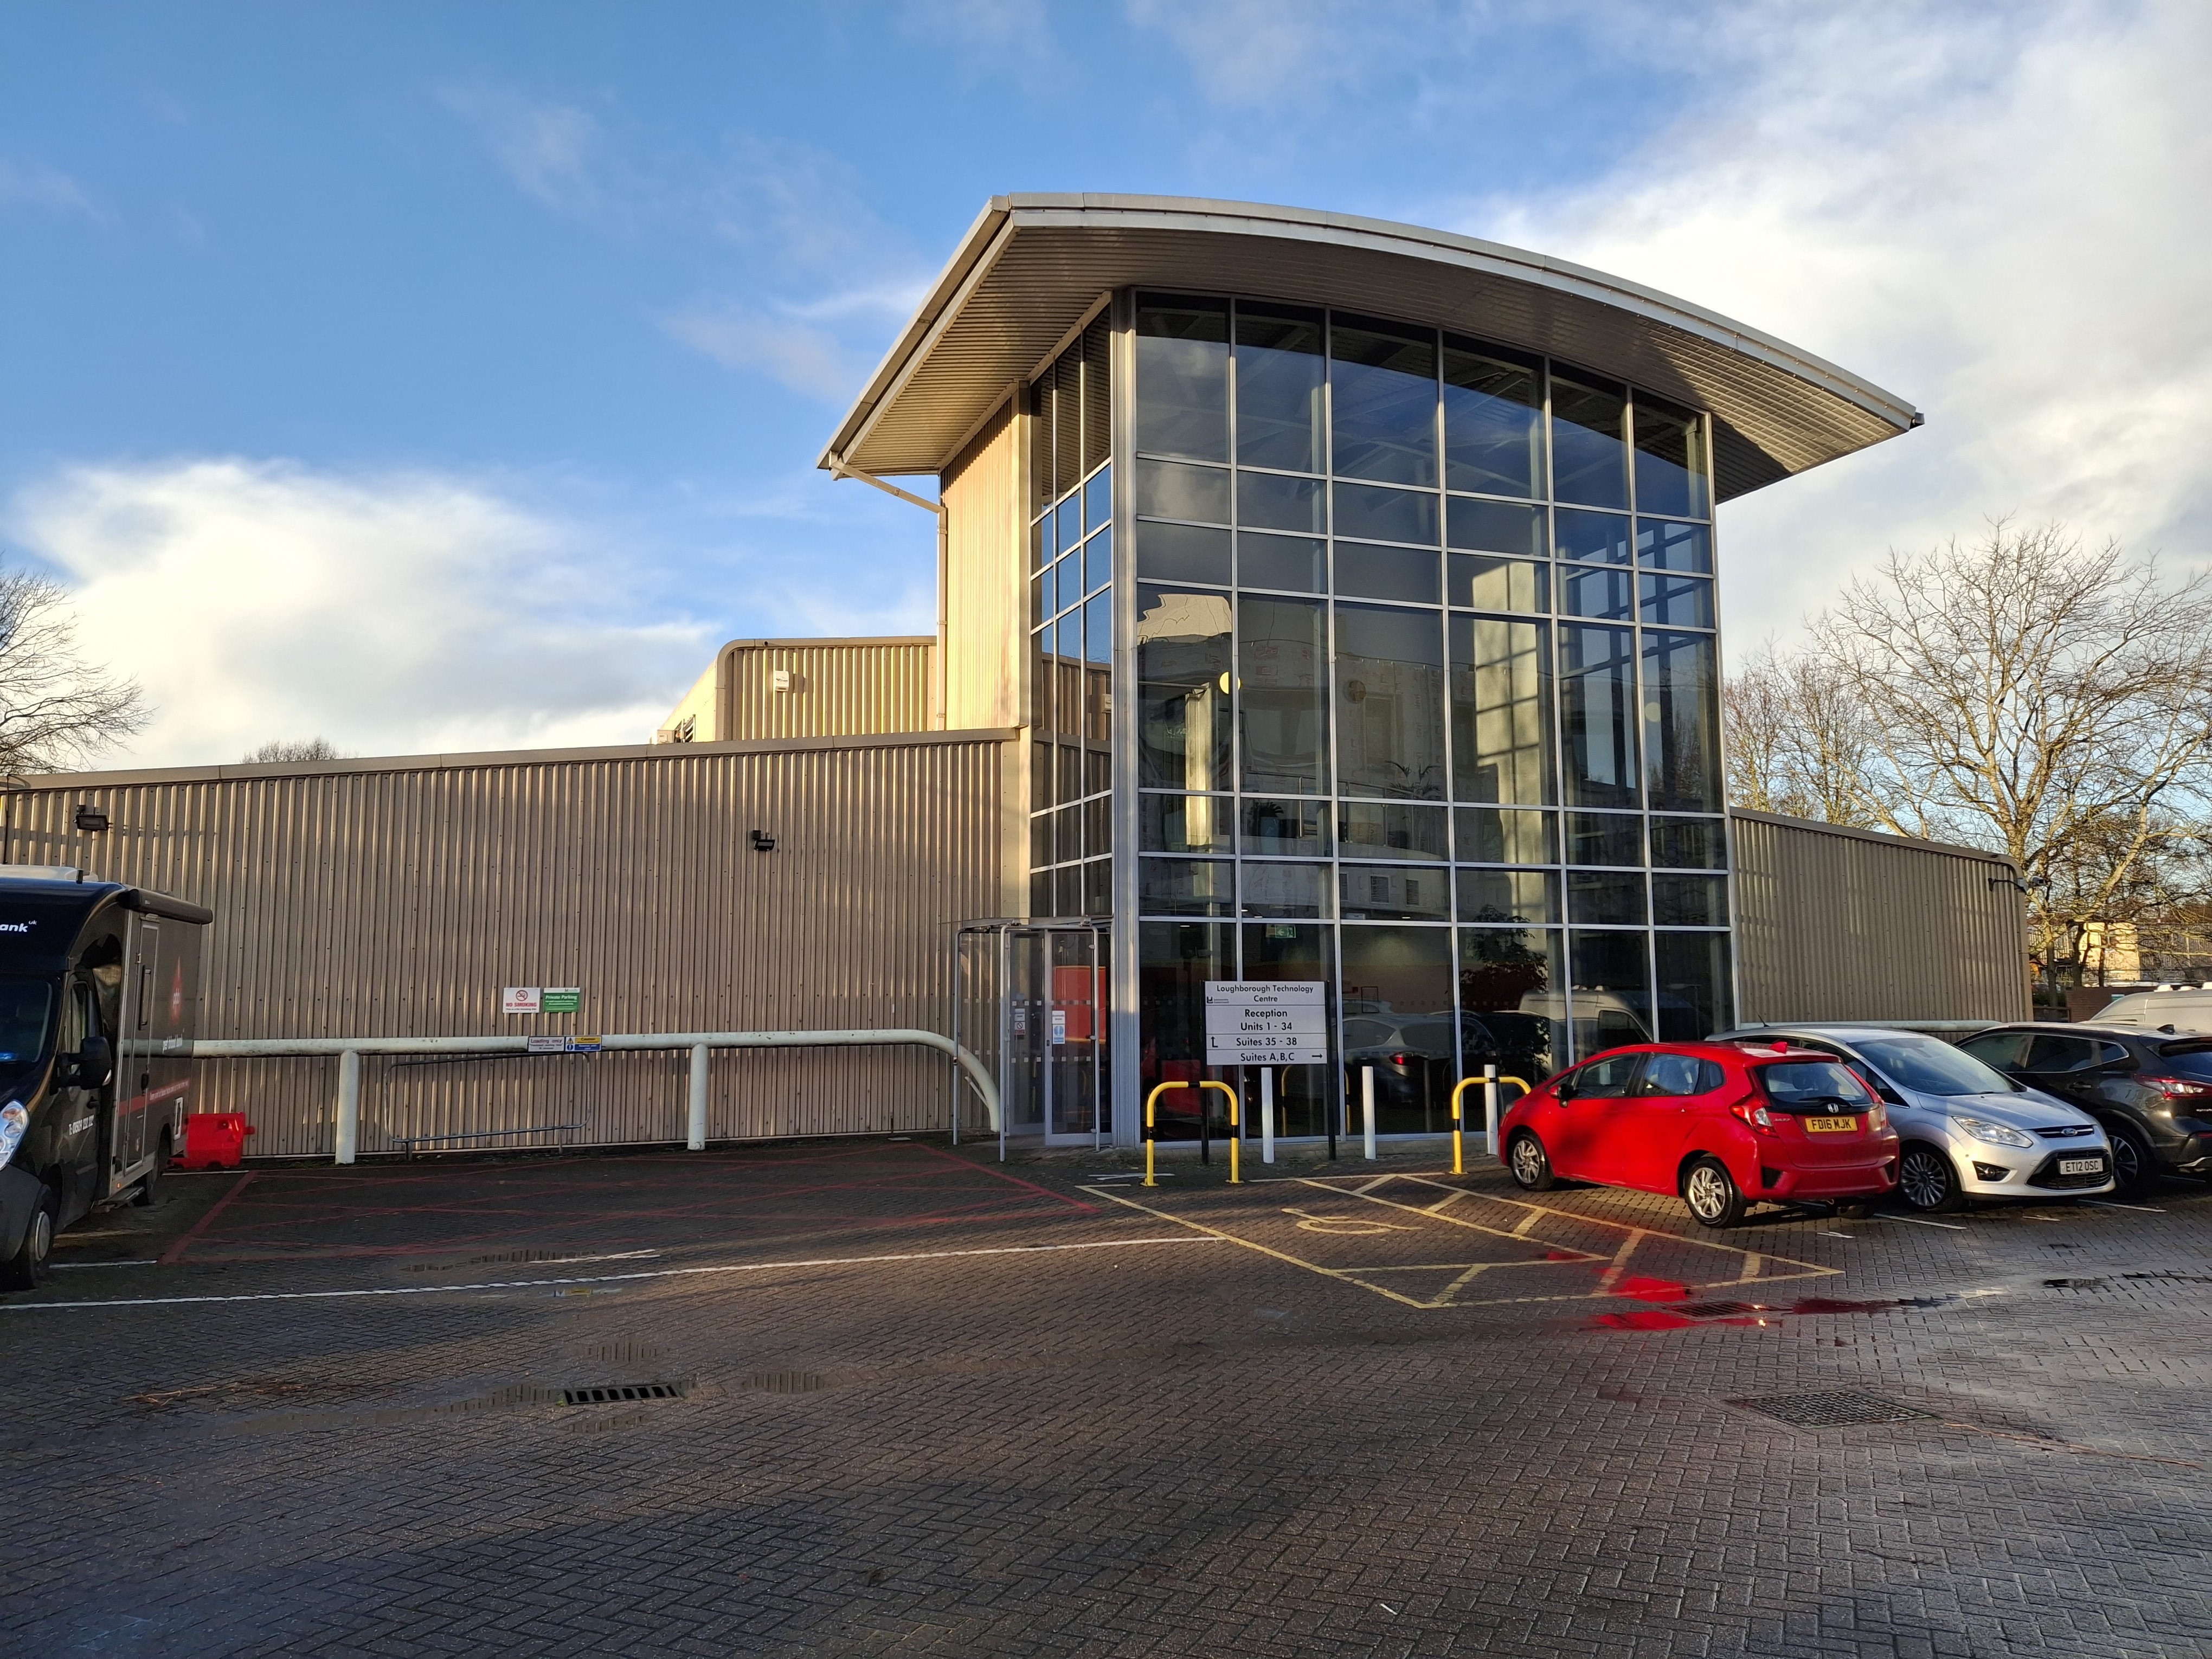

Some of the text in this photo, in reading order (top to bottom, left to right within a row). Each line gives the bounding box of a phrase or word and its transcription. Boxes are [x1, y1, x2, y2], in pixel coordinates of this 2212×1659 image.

[1217, 985, 1313, 993] Loughborough Technology
[1245, 1009, 1288, 1019] Reception
[1240, 1022, 1263, 1031] Units
[1266, 1022, 1270, 1031] 1
[1281, 1022, 1292, 1031] 34
[1236, 1037, 1262, 1046] Suites
[1265, 1037, 1276, 1046] 35
[1286, 1037, 1297, 1045] 38
[1240, 1053, 1295, 1062] Suites A,B,C
[1811, 1118, 1851, 1130] FD16 MJK
[2066, 1161, 2099, 1172] ET12 OSC
